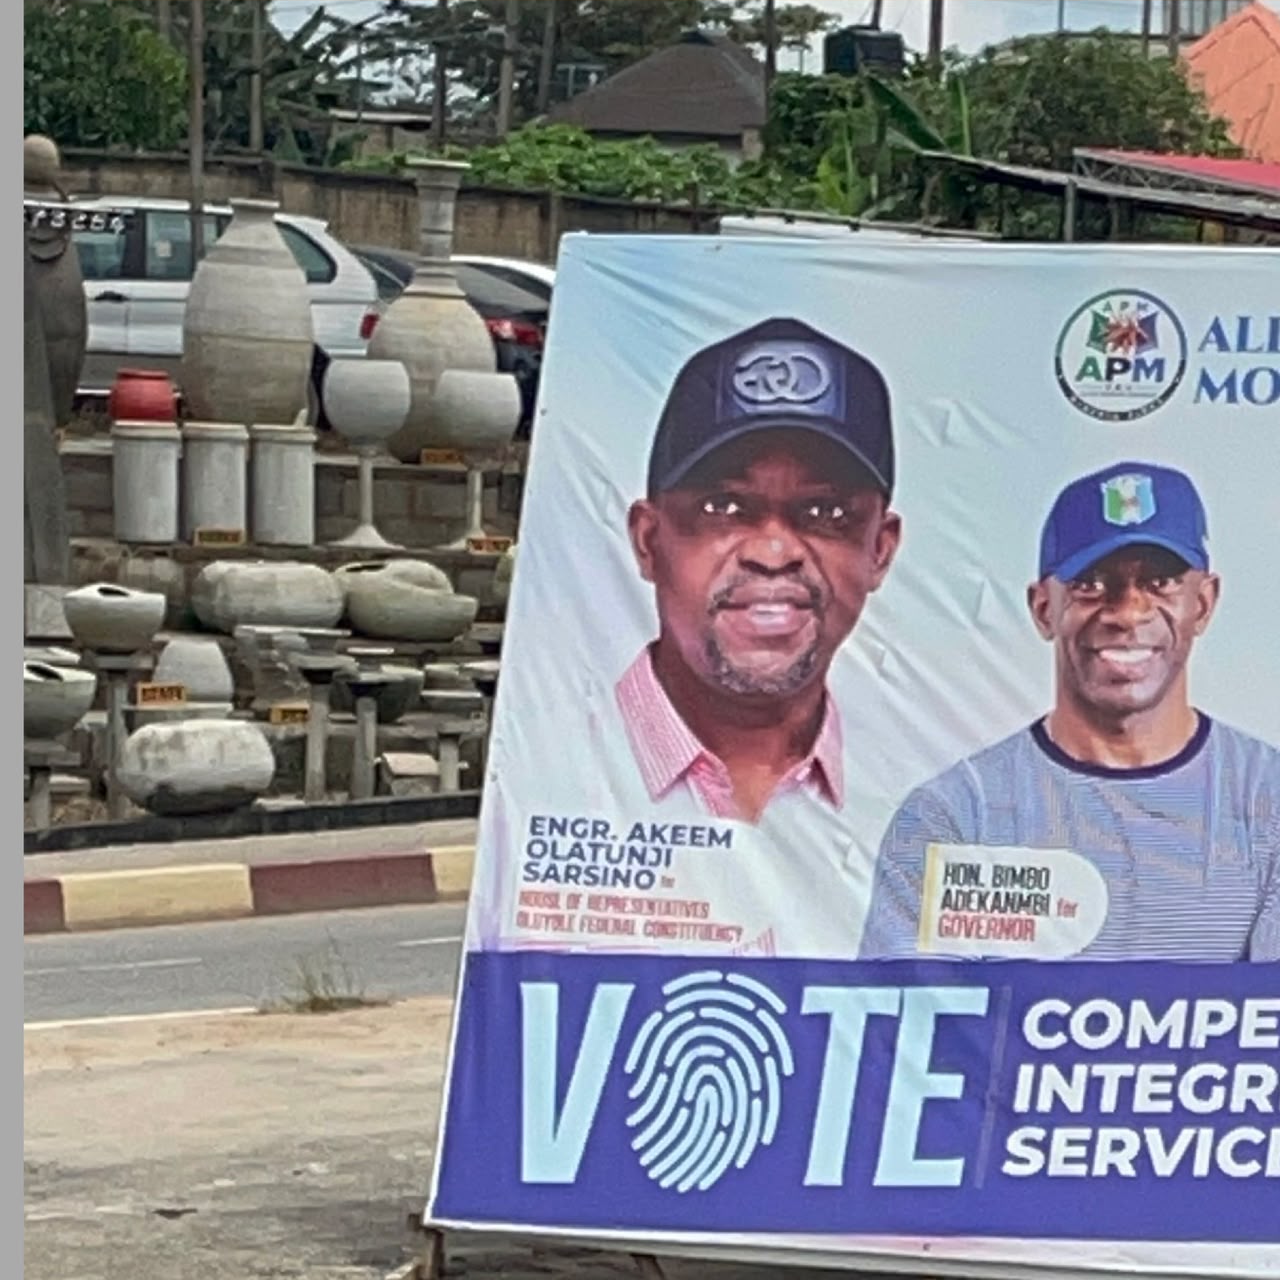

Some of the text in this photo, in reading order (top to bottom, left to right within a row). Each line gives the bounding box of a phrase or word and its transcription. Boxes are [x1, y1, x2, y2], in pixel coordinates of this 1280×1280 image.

[1075, 356, 1166, 382] APM
[529, 815, 733, 849] ENGR. AKEEM
[526, 839, 673, 868] OLATUNJI
[522, 862, 656, 890] SARSINO
[942, 863, 1051, 889] HON. BIMBO
[566, 893, 582, 910] OF
[941, 889, 1079, 918] ADEKANMBI for
[938, 914, 1036, 941] GOVERNOR
